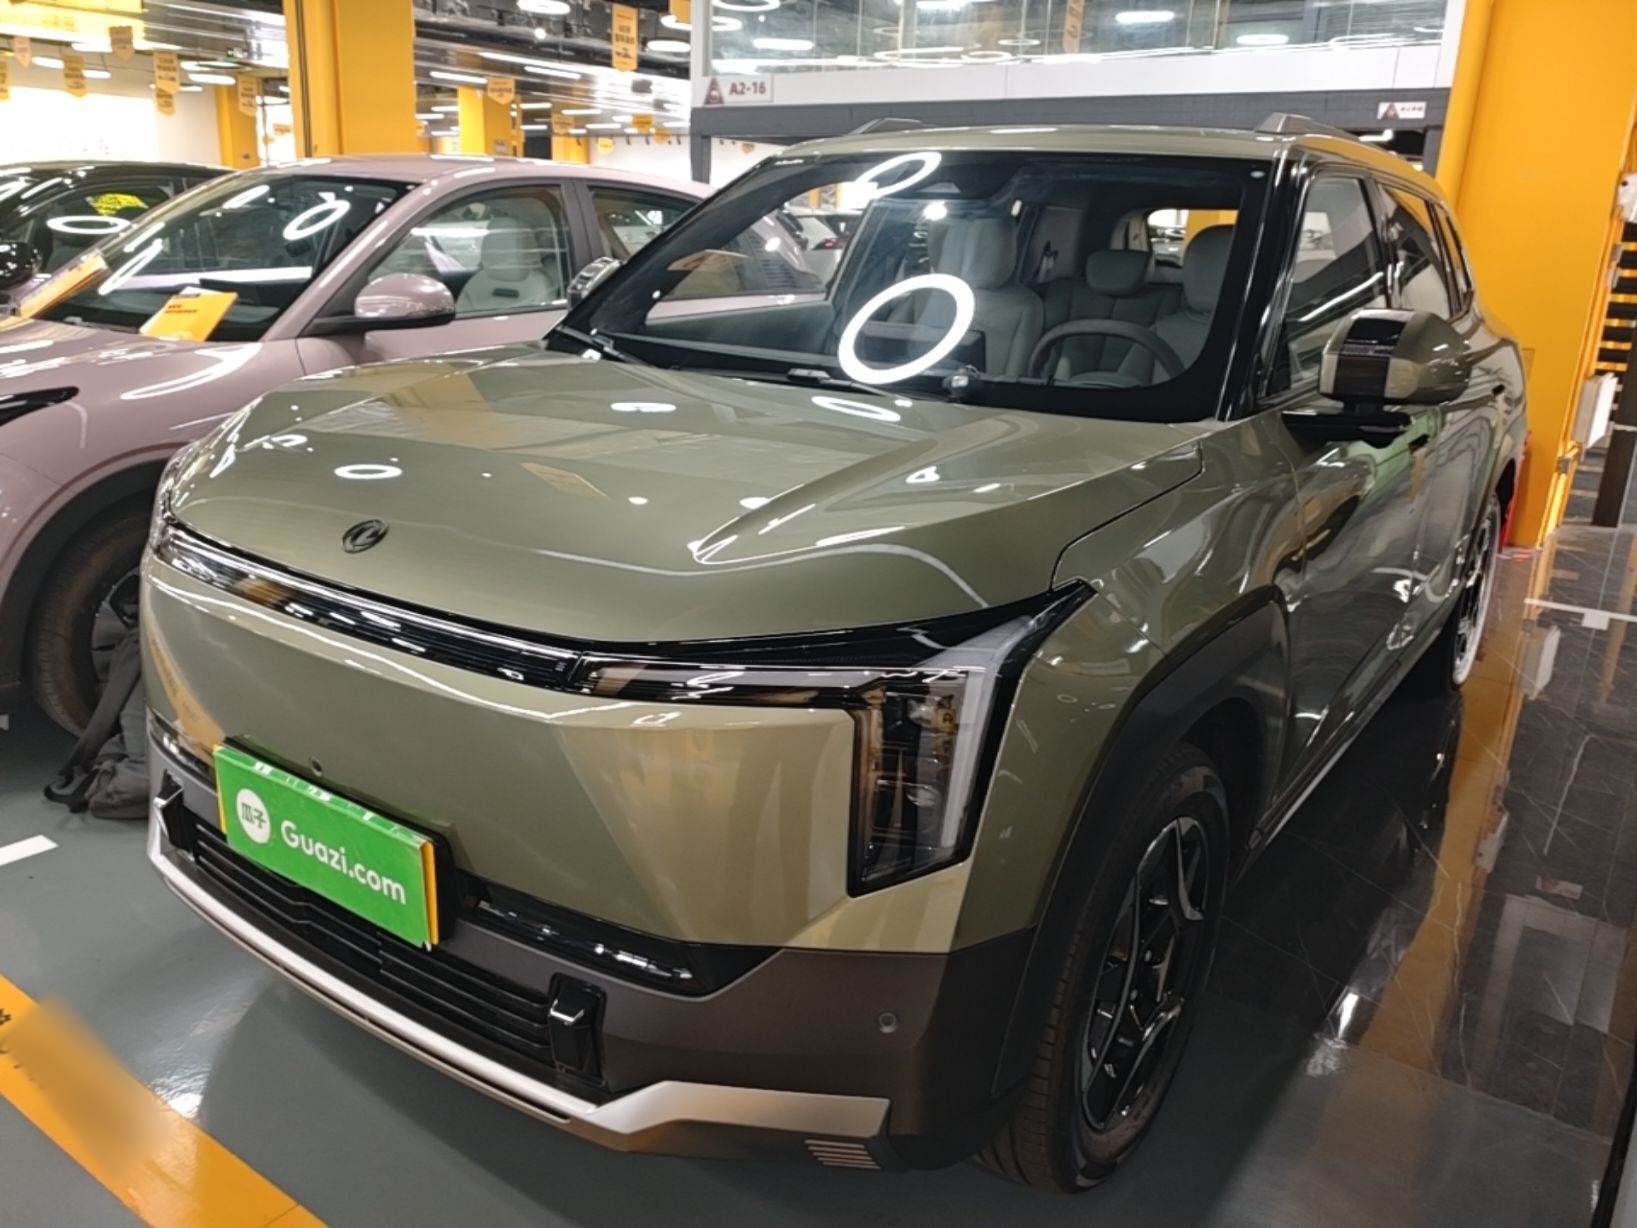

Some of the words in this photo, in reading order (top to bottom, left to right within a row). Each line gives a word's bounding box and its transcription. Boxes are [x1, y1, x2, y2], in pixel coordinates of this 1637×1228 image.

[729, 81, 767, 96] A2-16
[241, 802, 267, 829] 瓜子
[281, 820, 407, 905] Guazi.com
